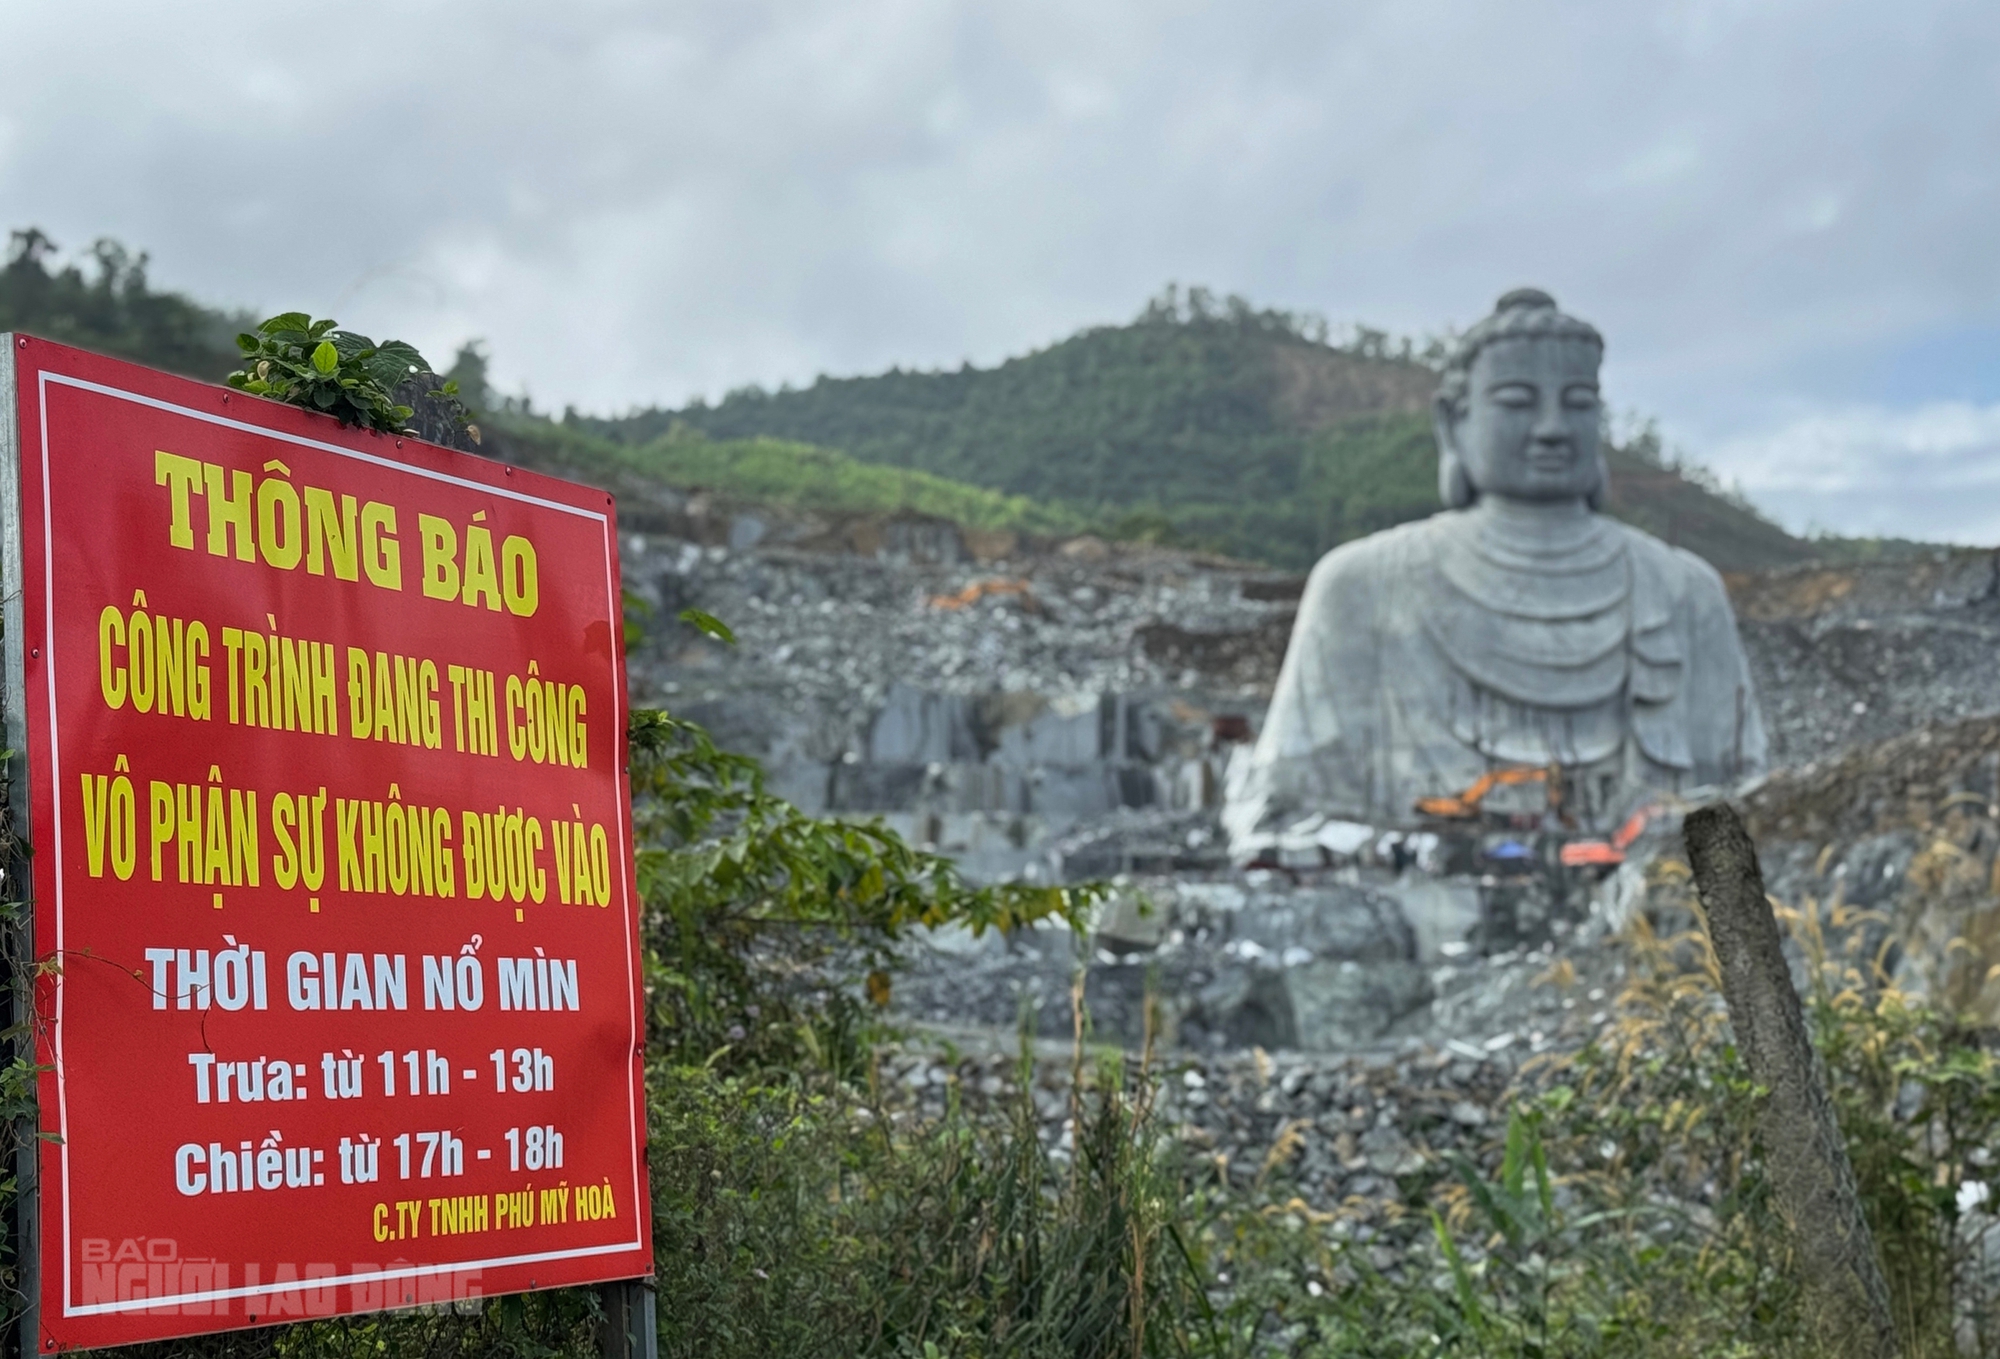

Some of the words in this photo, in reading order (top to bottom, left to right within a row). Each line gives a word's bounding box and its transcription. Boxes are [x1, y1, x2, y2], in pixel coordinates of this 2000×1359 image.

[154, 449, 403, 592] THÔNG
[418, 509, 539, 618] BÁO
[99, 588, 211, 721] CÔNG
[222, 612, 338, 736] TRÌNH
[347, 646, 442, 750] ĐANG
[447, 664, 499, 758] THI
[505, 659, 588, 769] CÔNG
[80, 753, 136, 881] VÔ
[150, 764, 260, 909] PHẬN
[271, 786, 327, 913] SỰ
[335, 782, 456, 899] KHÔNG
[461, 804, 547, 923] ĐƯỢC
[550, 802, 611, 908] VÀO
[144, 934, 268, 1011] THỜI
[286, 950, 408, 1011] GIAN
[422, 933, 484, 1012] NỔ
[497, 946, 580, 1012] MÌN
[188, 1052, 307, 1104] Trưa:
[320, 1049, 365, 1100] từ
[377, 1049, 450, 1097] 11h
[462, 1069, 477, 1080] -
[489, 1047, 554, 1093] 13h
[175, 1130, 325, 1196] Chiều:
[338, 1133, 381, 1185] từ
[393, 1130, 464, 1180] 17h
[477, 1149, 491, 1160] -
[504, 1124, 564, 1172] 18h
[373, 1200, 422, 1242] C.TY
[428, 1194, 489, 1237] TNHH
[495, 1190, 534, 1230] PHÚ
[540, 1181, 570, 1225] MỸ
[575, 1177, 617, 1222] HOÀ
